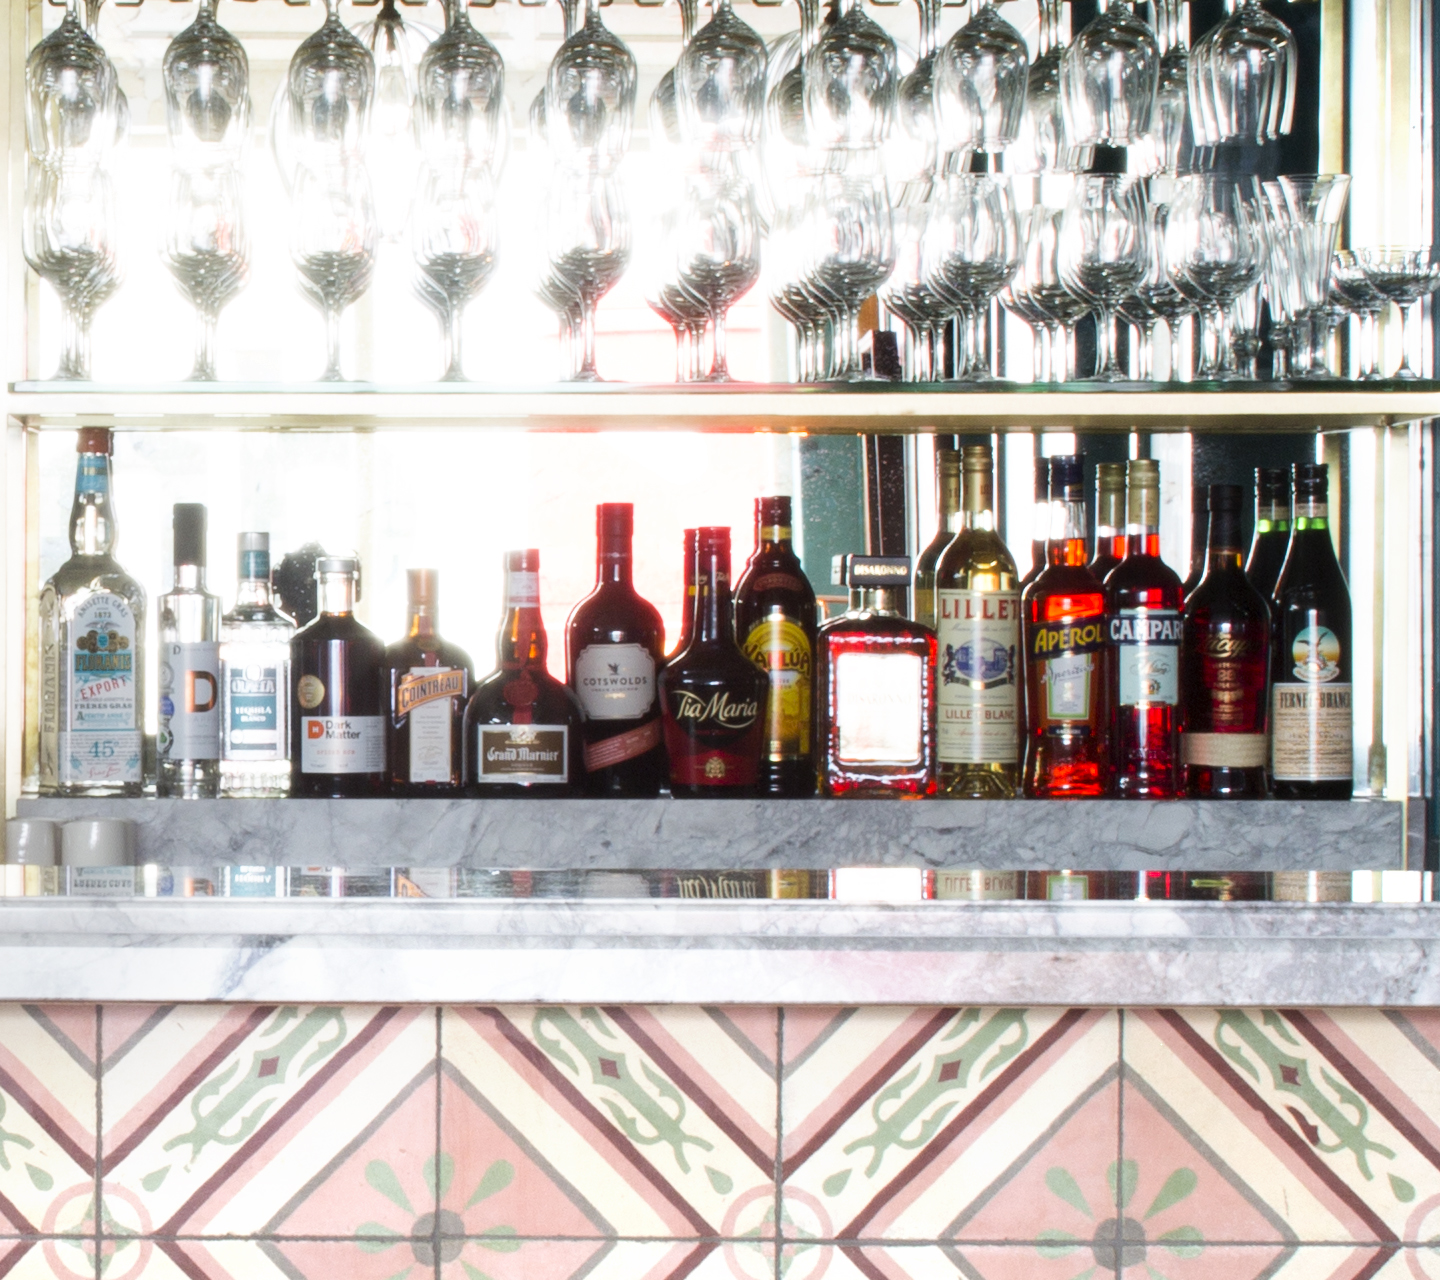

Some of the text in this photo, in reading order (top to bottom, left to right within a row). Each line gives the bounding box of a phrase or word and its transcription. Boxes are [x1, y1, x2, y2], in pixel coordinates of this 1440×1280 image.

[941, 597, 1018, 620] LILLET
[1034, 623, 1103, 654] APEROL
[1110, 618, 1184, 641] CAMPARI
[743, 643, 811, 677] ALÚA
[80, 674, 128, 701] EXPORT
[184, 669, 219, 714] D
[401, 675, 460, 709] COINTREAU
[582, 676, 648, 687] COTSWOLDS
[673, 690, 758, 723] Tia Maria
[1279, 691, 1318, 709] FERNE
[945, 709, 978, 720] LILLE
[486, 746, 559, 762] Grand Marnier
